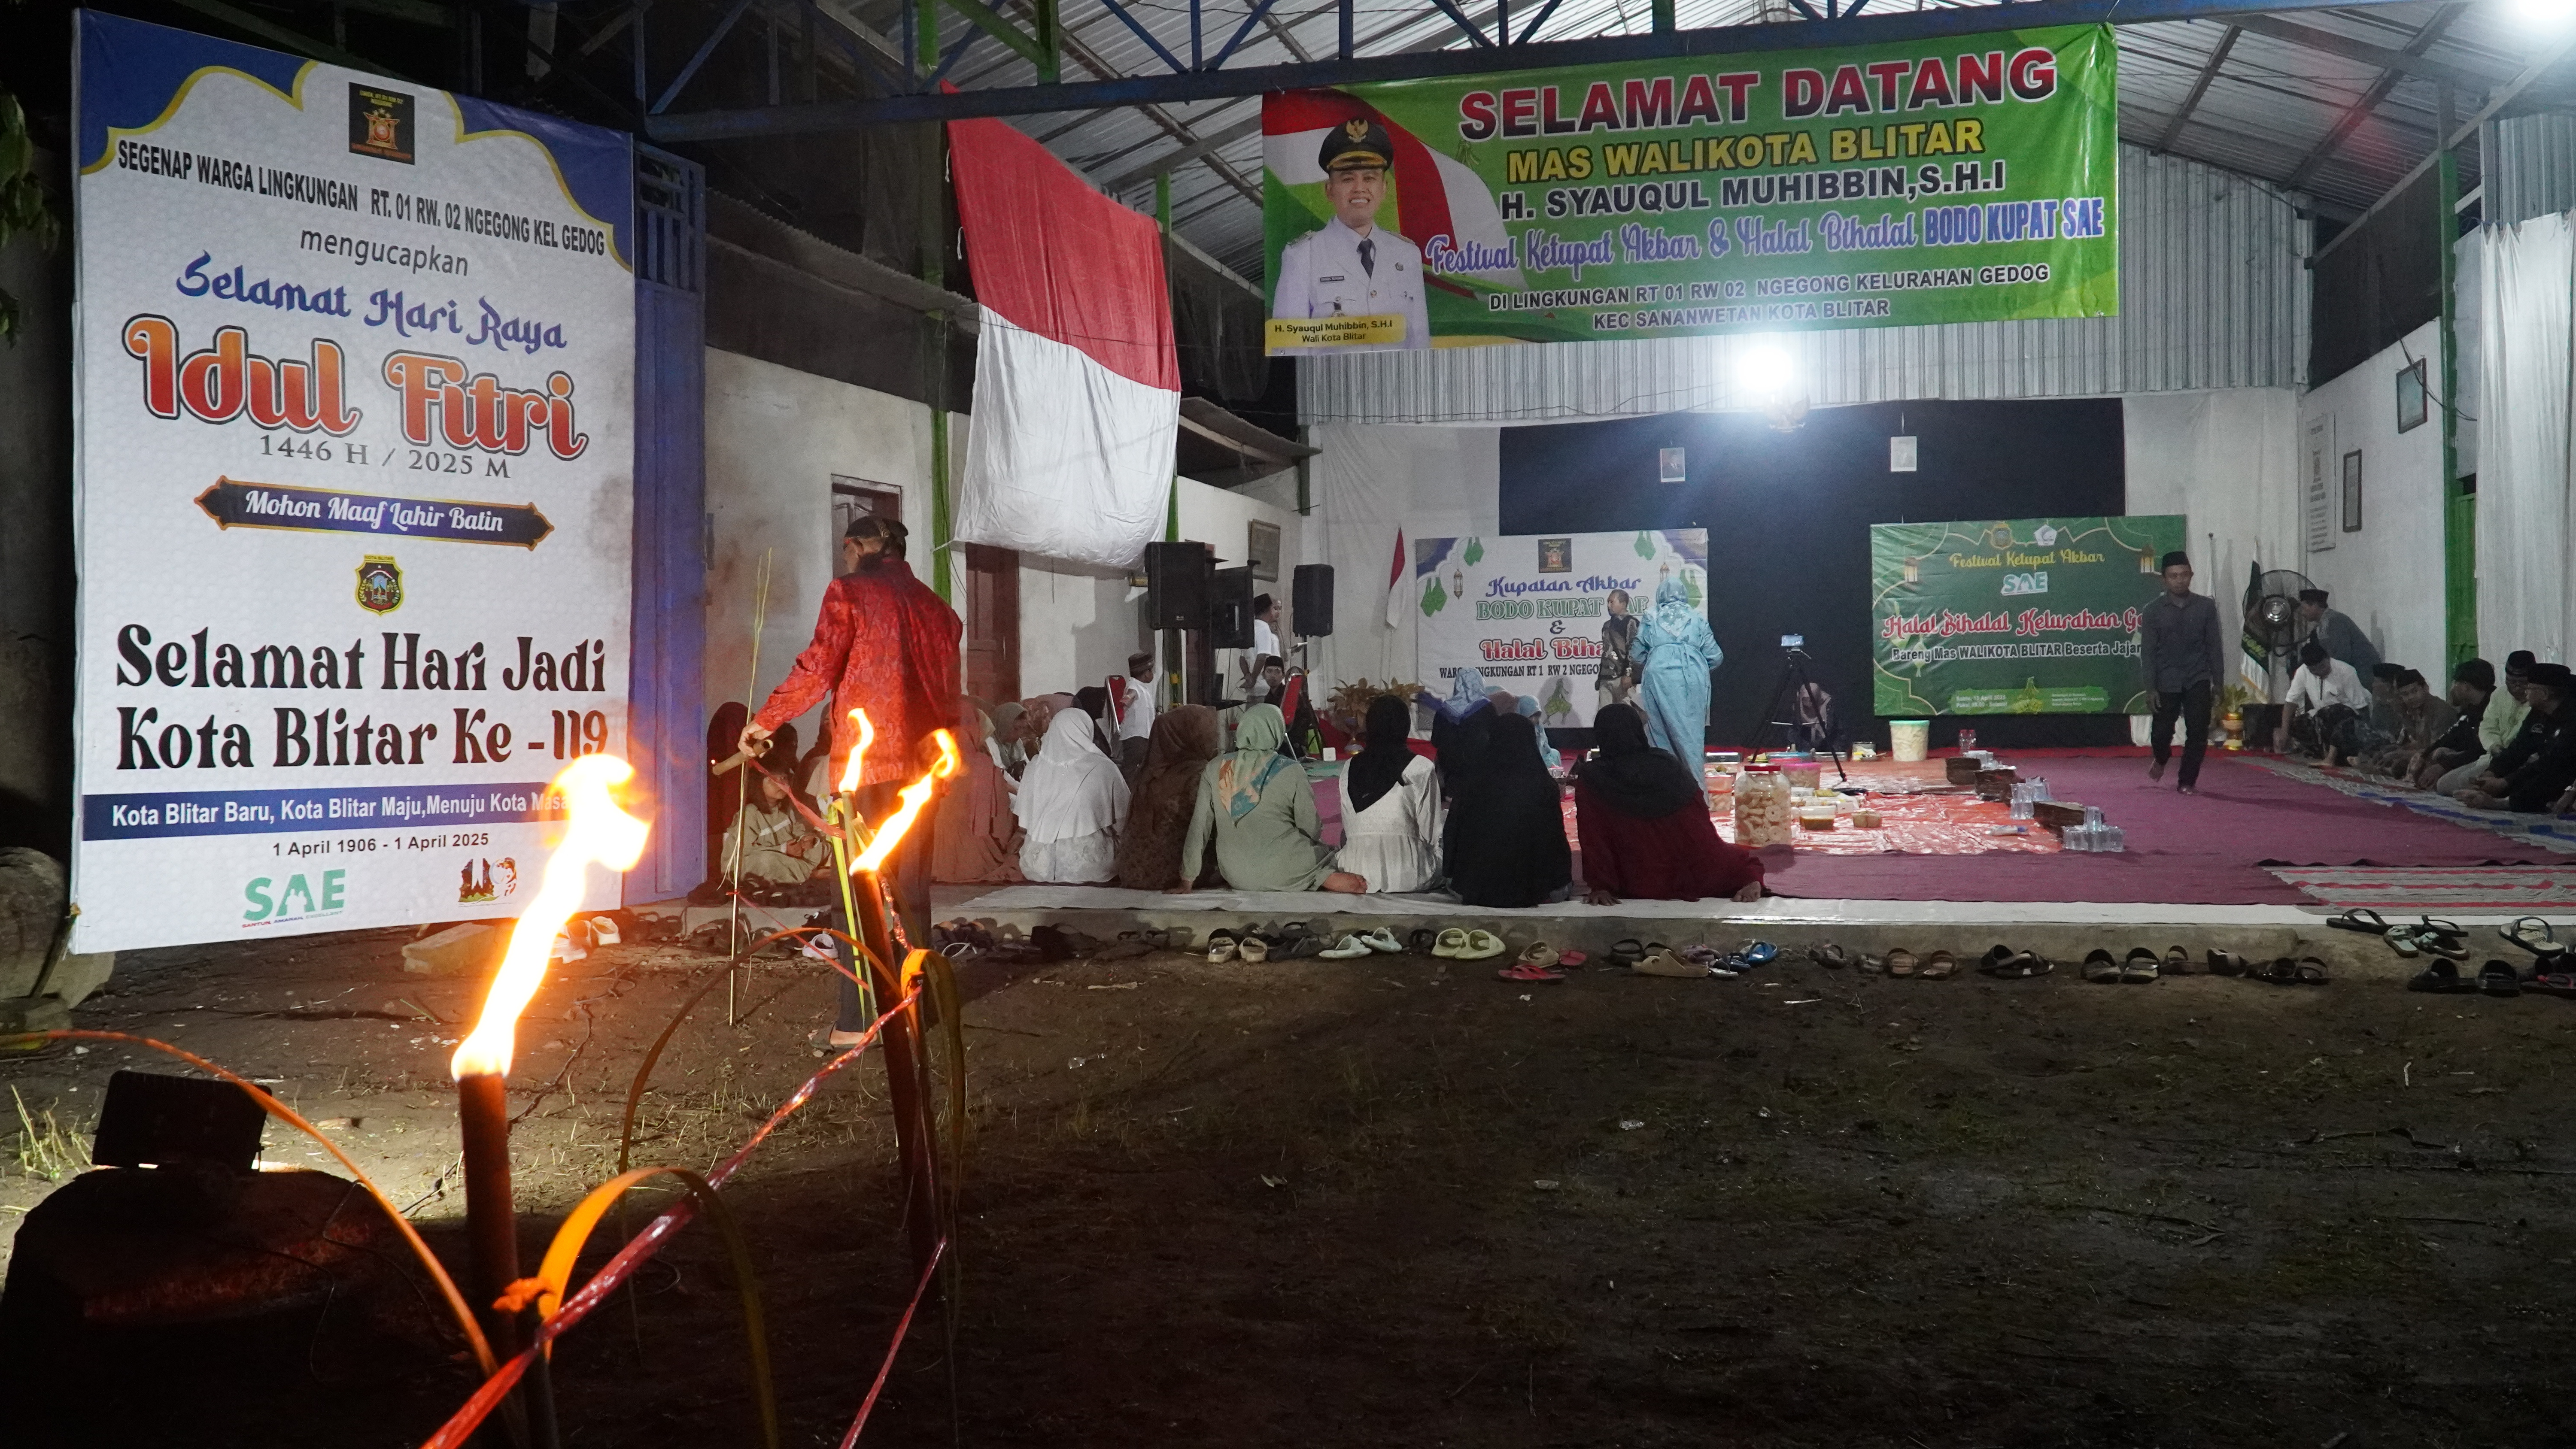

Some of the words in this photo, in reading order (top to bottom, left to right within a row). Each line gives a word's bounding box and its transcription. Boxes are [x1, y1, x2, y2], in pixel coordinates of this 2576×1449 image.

[1459, 71, 1760, 142] SELAMAT
[1783, 47, 2057, 121] DATANG
[1506, 142, 1593, 184] MAS
[1604, 131, 1817, 176] WALIKOTA
[1830, 117, 1985, 162] BLITAR
[118, 140, 191, 180] SEGENAP
[198, 155, 254, 192] WARGA
[259, 167, 358, 212] LINGKUNGAN
[371, 189, 392, 217] RT.
[396, 192, 411, 220] 01
[416, 196, 440, 227] RW.
[445, 201, 461, 231] 02
[465, 205, 530, 243] NGEGONG
[534, 219, 558, 247] KEL
[562, 224, 605, 255] GEDOG
[1500, 192, 1534, 221] H.
[1546, 180, 1709, 218] SYAUQUL
[1722, 160, 2006, 207] MUHIBBIN,S.H.I
[300, 227, 468, 277] mengucapkan
[1426, 234, 1518, 276] Festival
[1526, 229, 1613, 282] Ketupat
[1621, 222, 1701, 261] Akbar
[1708, 218, 1730, 255] &
[1735, 214, 1813, 254] Halal
[1820, 210, 1917, 252] Bihalal
[1924, 204, 1982, 246] BODO
[1986, 199, 2059, 242] KUPAT
[2062, 198, 2105, 238] SAE
[176, 250, 350, 317] Selamat
[364, 288, 463, 336] Hari
[466, 296, 567, 354] Raya
[1489, 293, 1507, 311] DI
[1511, 287, 1629, 310] LINGKUNGAN
[1636, 288, 1658, 304] RT
[1664, 286, 1684, 301] 01
[1689, 282, 1718, 299] RW
[1725, 282, 1744, 298] 02
[1756, 277, 1849, 296] NGEGONG
[1857, 269, 1972, 291] KELURAHAN
[1980, 264, 2050, 284] GEDOG
[1286, 323, 1323, 334] Syauqul
[1325, 320, 1369, 332] Muhibbin,
[1371, 320, 1392, 328] S.H.I
[1593, 313, 1630, 331] KEC
[1635, 305, 1760, 330] SANANWETAN
[1768, 303, 1817, 321] KOTA
[1823, 300, 1889, 319] BLITAR
[1302, 334, 1318, 343] Wali
[1343, 332, 1366, 341] Blitar
[122, 314, 361, 438] Idul
[381, 349, 589, 460] Fitri
[260, 435, 332, 462] 1446
[346, 443, 369, 465] H
[382, 448, 397, 468] /
[408, 449, 474, 474] 2025
[485, 460, 510, 478] M
[246, 490, 321, 519] Mohon
[328, 496, 389, 528] Maaf
[390, 500, 444, 530] Lahir
[449, 506, 503, 533] Batin
[1949, 553, 2001, 567] Festival
[2007, 551, 2055, 570] Ketupat
[2061, 549, 2105, 563] Akbar
[1485, 576, 1573, 597] Kupatan
[1576, 575, 1642, 593] Akbar
[2004, 573, 2046, 592] SAE
[1476, 600, 1534, 620] BODO
[1537, 597, 1604, 619] KUPAT
[1550, 620, 1566, 634] &
[1882, 614, 1939, 639] Halal
[1940, 609, 2011, 637] Bihalal
[2016, 608, 2122, 636] Kelurahan
[116, 624, 364, 689] Selamat
[380, 632, 487, 691] Hari
[503, 637, 606, 692] Jadi
[1479, 638, 1548, 661] Halal
[1550, 637, 1603, 659] Biha
[1892, 647, 1932, 663] Bareng
[1934, 646, 1957, 660] Mas
[1958, 645, 2018, 659] WALIKOTA
[2020, 643, 2062, 657] BLITAR
[2064, 642, 2110, 655] Beserta
[2112, 641, 2142, 657] Jajar
[1527, 666, 1537, 676] RT
[1539, 665, 1543, 676] 1
[1548, 664, 1560, 676] RW
[1563, 664, 1567, 675] 2
[1570, 664, 1601, 675] NGEGO
[116, 707, 254, 770] Kota
[273, 707, 437, 767] Blitar
[452, 708, 512, 764] Ke
[113, 803, 159, 827] Kota
[165, 801, 219, 824] Blitar
[225, 801, 274, 825] Baru,
[280, 800, 324, 821] Kota
[329, 797, 377, 818] Blitar
[489, 793, 526, 812] Kota
[273, 843, 280, 855] 1
[288, 839, 331, 858] April
[337, 837, 376, 853] 1906
[395, 837, 401, 850] 1
[408, 834, 447, 852] April
[453, 832, 489, 848] 2025
[243, 869, 345, 921] SAE
